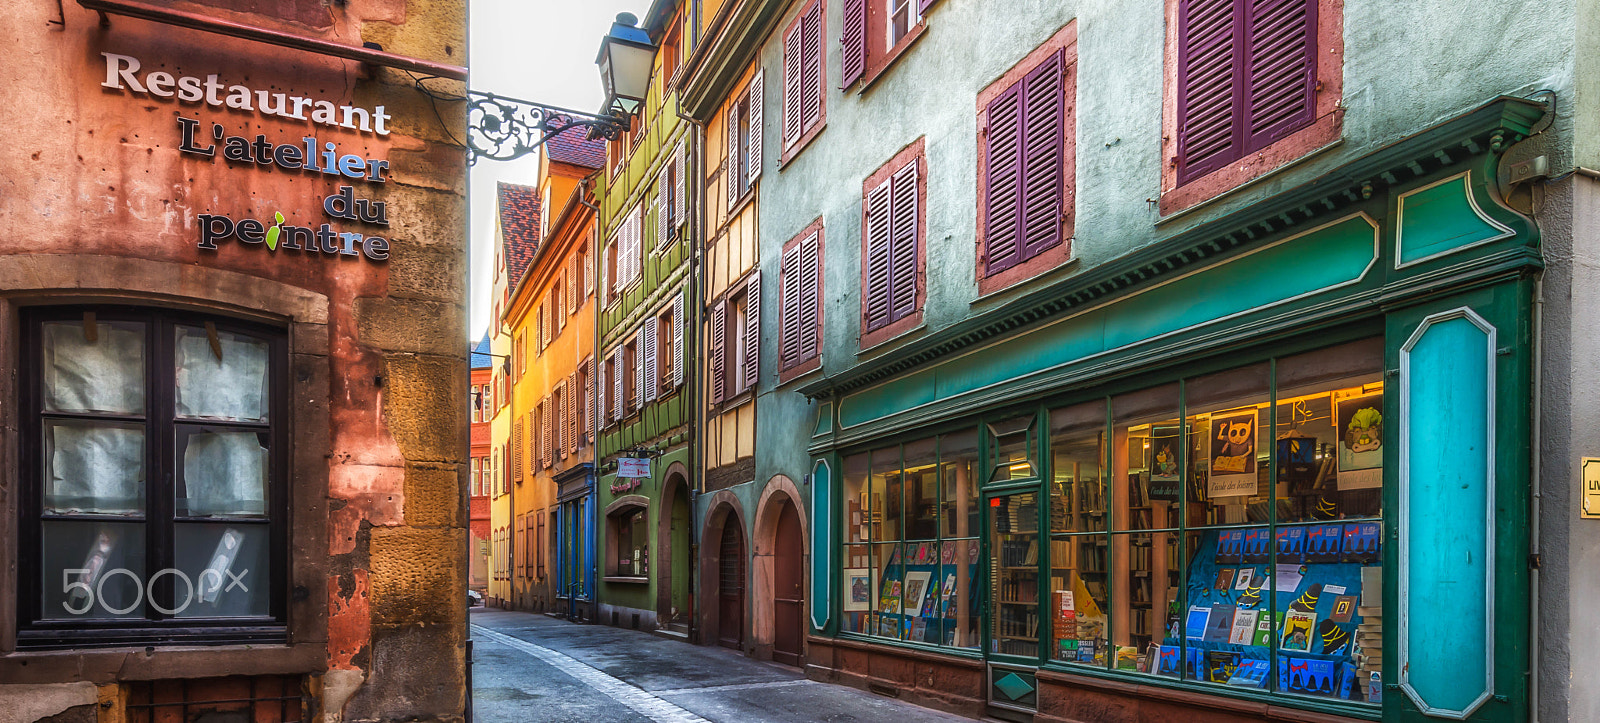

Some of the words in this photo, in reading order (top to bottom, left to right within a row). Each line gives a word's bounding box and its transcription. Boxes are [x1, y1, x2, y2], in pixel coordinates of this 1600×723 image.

[100, 51, 391, 136] Restaurant
[177, 117, 389, 183] L'atelier
[323, 186, 389, 225] du
[197, 211, 390, 261] peintre
